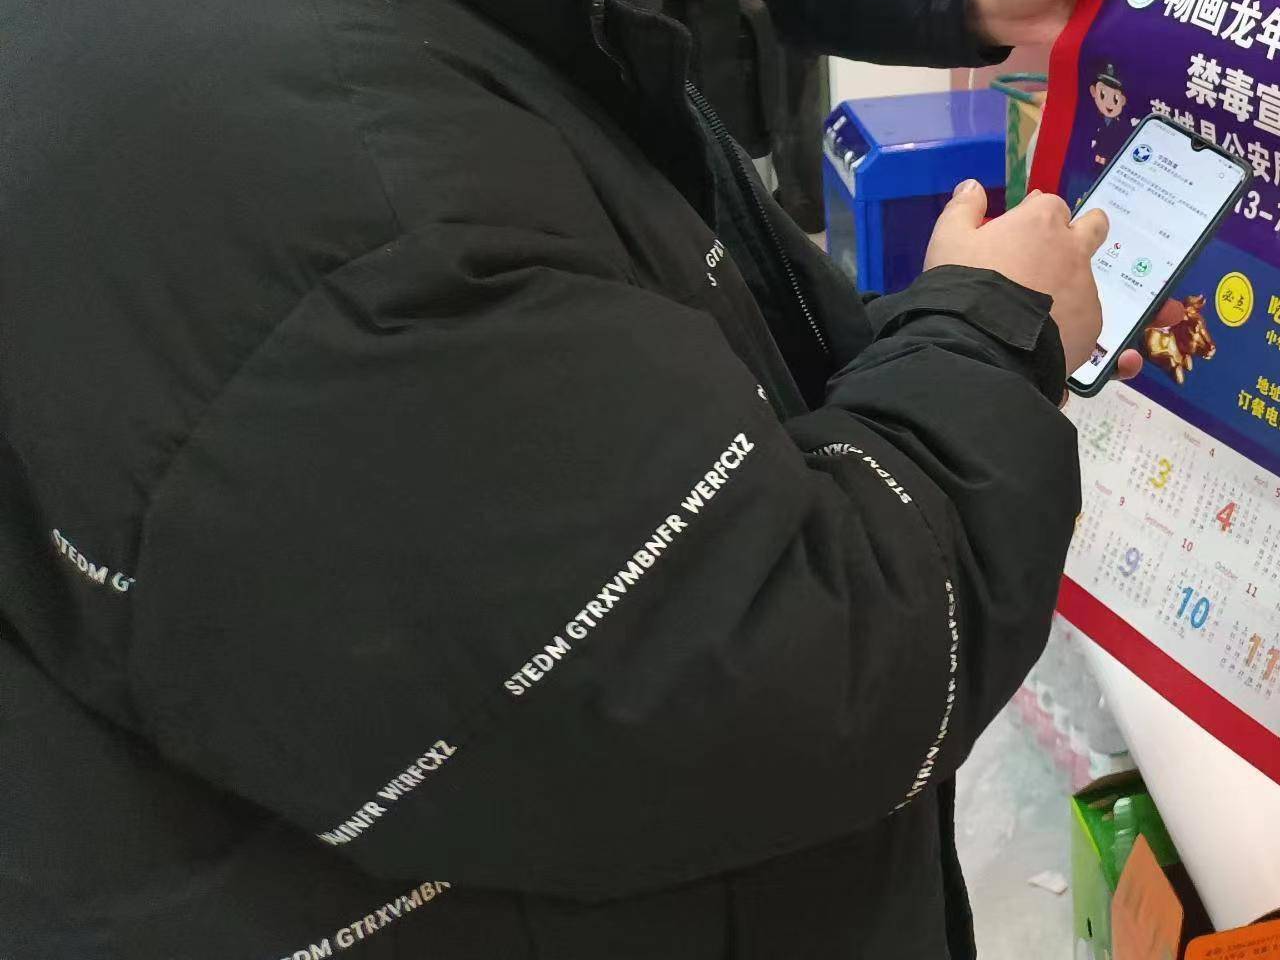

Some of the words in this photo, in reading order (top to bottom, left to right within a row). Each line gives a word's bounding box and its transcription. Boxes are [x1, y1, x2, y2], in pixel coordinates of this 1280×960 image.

[1150, 458, 1172, 489] 3
[1216, 500, 1238, 533] 4
[504, 635, 572, 696] STEDM
[565, 514, 688, 640] GTRXVMBNFR
[681, 433, 755, 514] WERFCXZ
[1118, 546, 1141, 578] 9
[1246, 583, 1258, 598] 11
[1176, 586, 1210, 629] 10
[1249, 633, 1280, 681] 11
